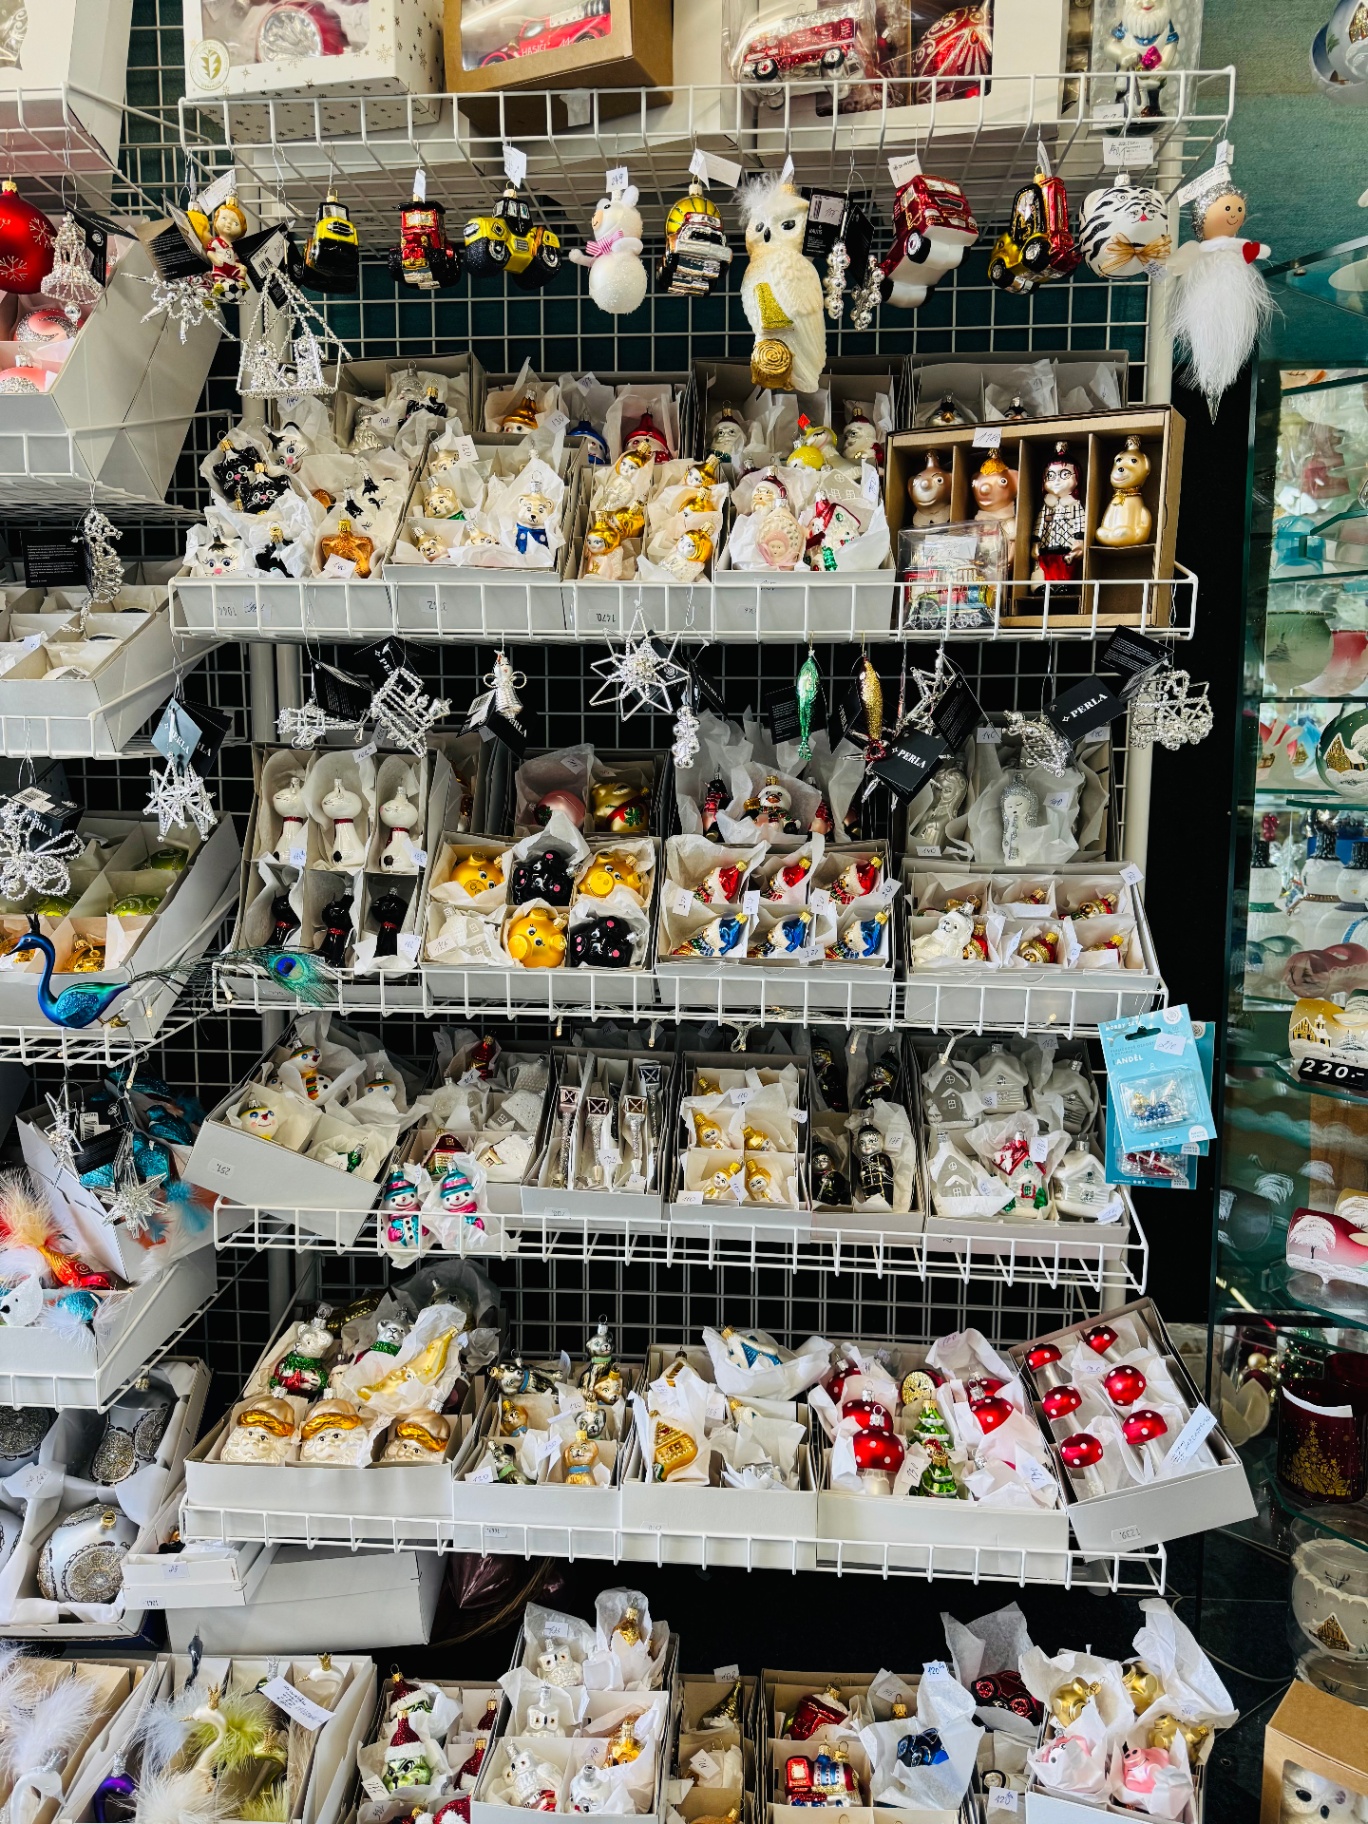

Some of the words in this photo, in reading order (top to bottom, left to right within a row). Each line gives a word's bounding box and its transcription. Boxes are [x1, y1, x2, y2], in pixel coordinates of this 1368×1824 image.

[521, 40, 547, 56] HASIČI
[1069, 693, 1108, 719] PERLA
[897, 749, 927, 769] PERLA
[1302, 1059, 1365, 1079] 220.-
